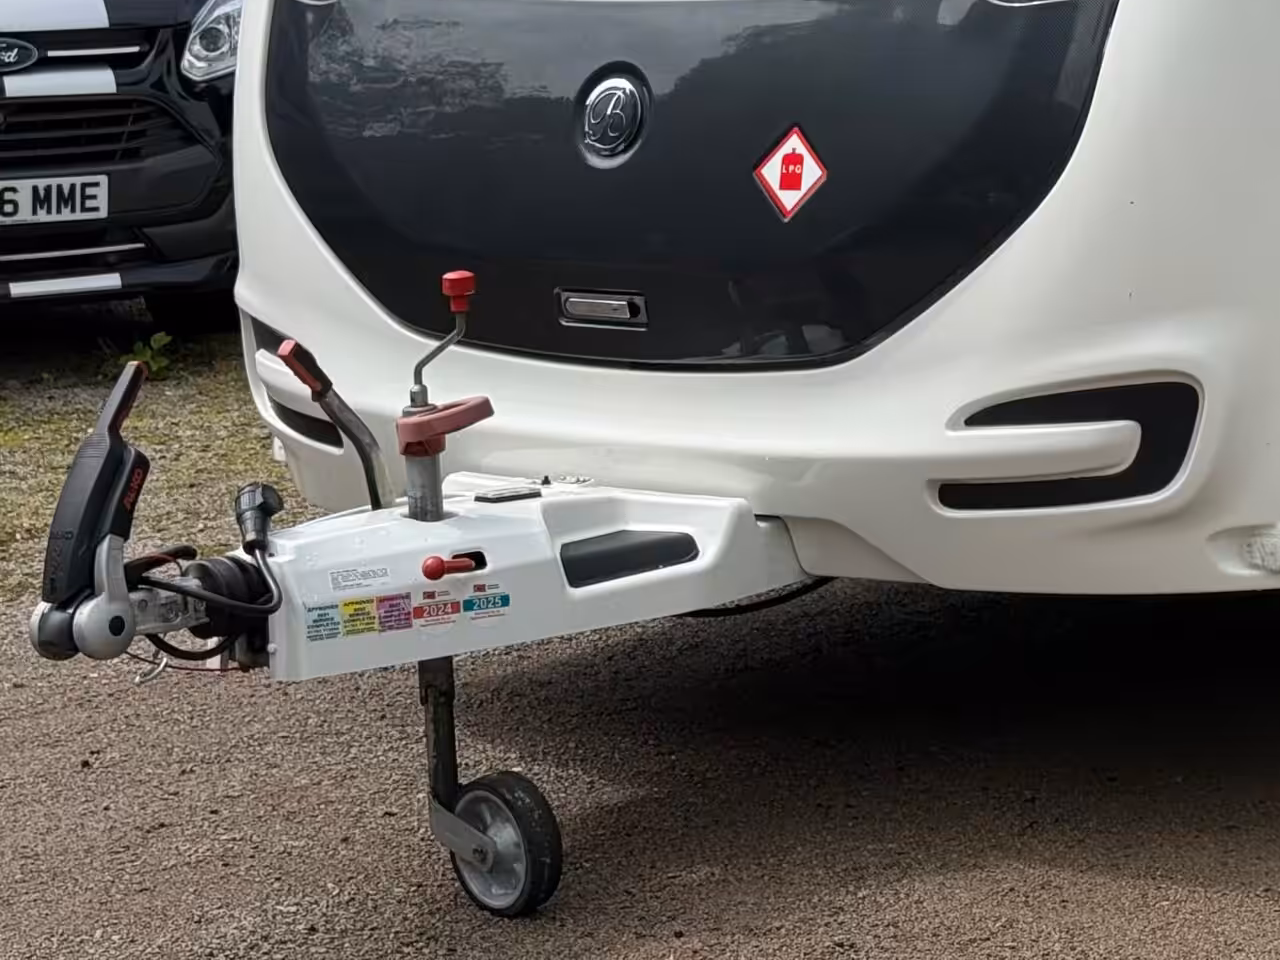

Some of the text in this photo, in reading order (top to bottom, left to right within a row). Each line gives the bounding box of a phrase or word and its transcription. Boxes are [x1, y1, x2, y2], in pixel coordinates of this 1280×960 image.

[782, 163, 803, 175] LPG
[32, 181, 101, 217] MME
[472, 596, 503, 610] 2025
[422, 603, 453, 618] 2024
